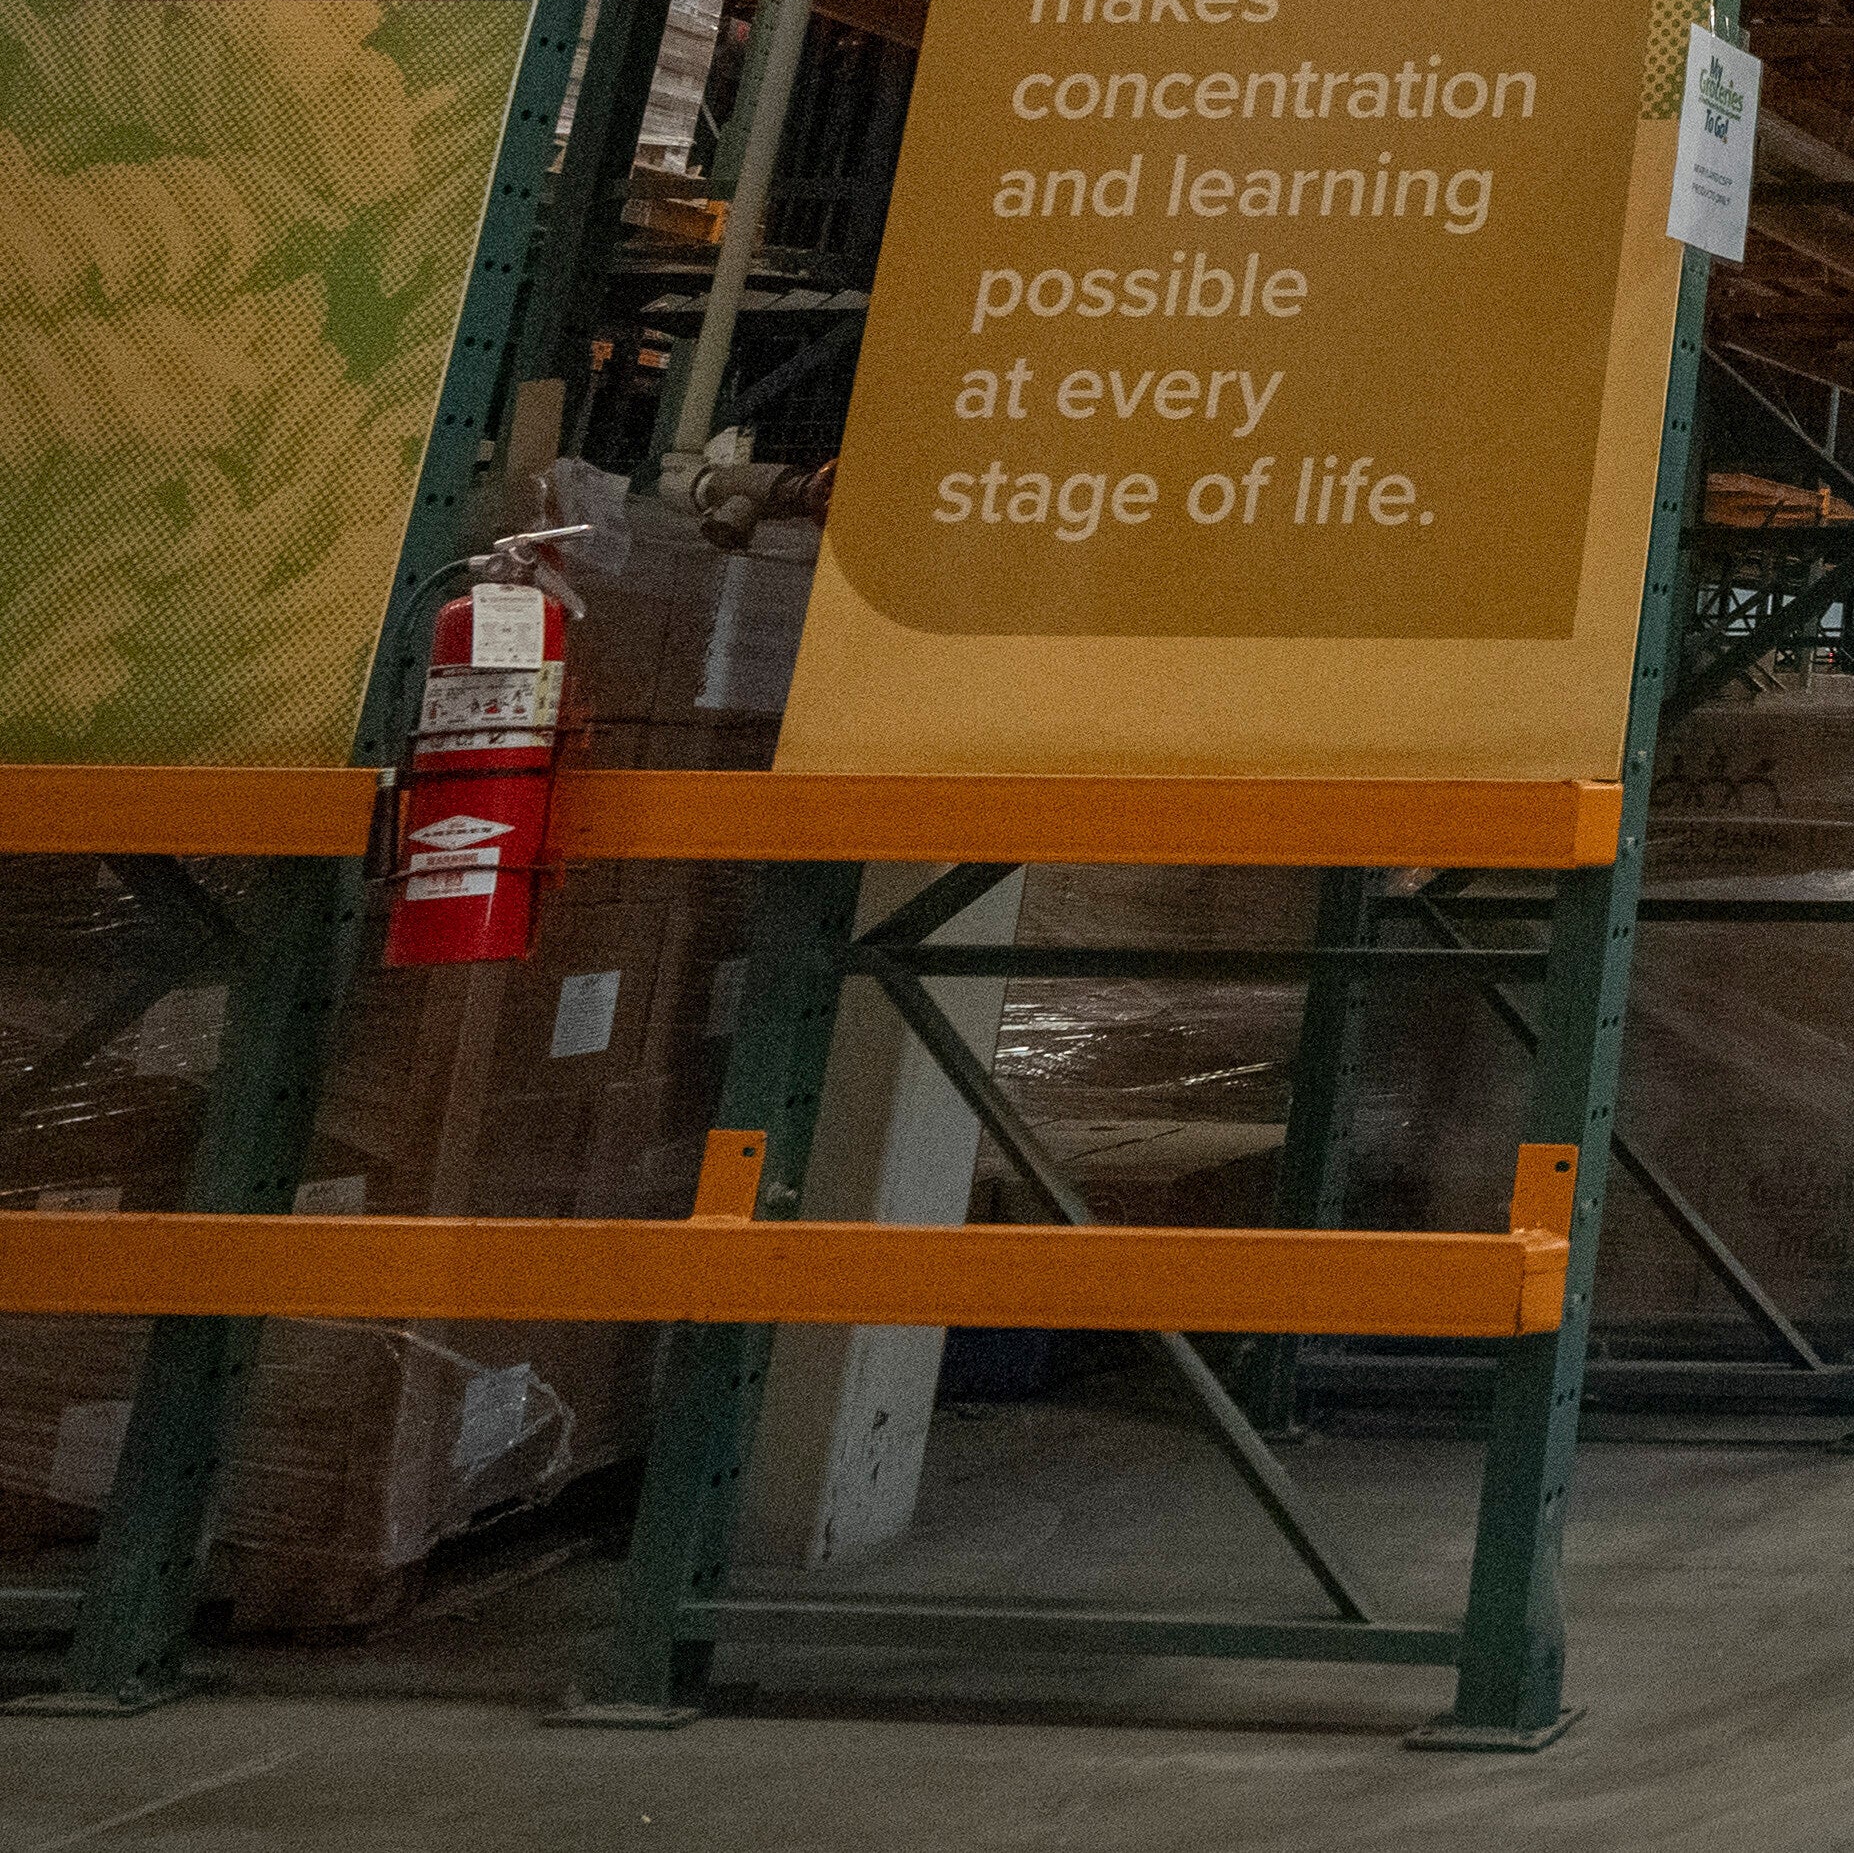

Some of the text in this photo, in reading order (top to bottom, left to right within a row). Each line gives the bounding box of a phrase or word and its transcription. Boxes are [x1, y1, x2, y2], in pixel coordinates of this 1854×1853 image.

[1012, 54, 1537, 120] concentration
[1700, 68, 1743, 112] Groceries
[1710, 56, 1723, 86] My
[1704, 108, 1729, 144] To Go!
[993, 152, 1493, 234] and learning
[971, 251, 1308, 333] possible
[955, 358, 1284, 438] at every
[933, 455, 1436, 542] stage of life.
